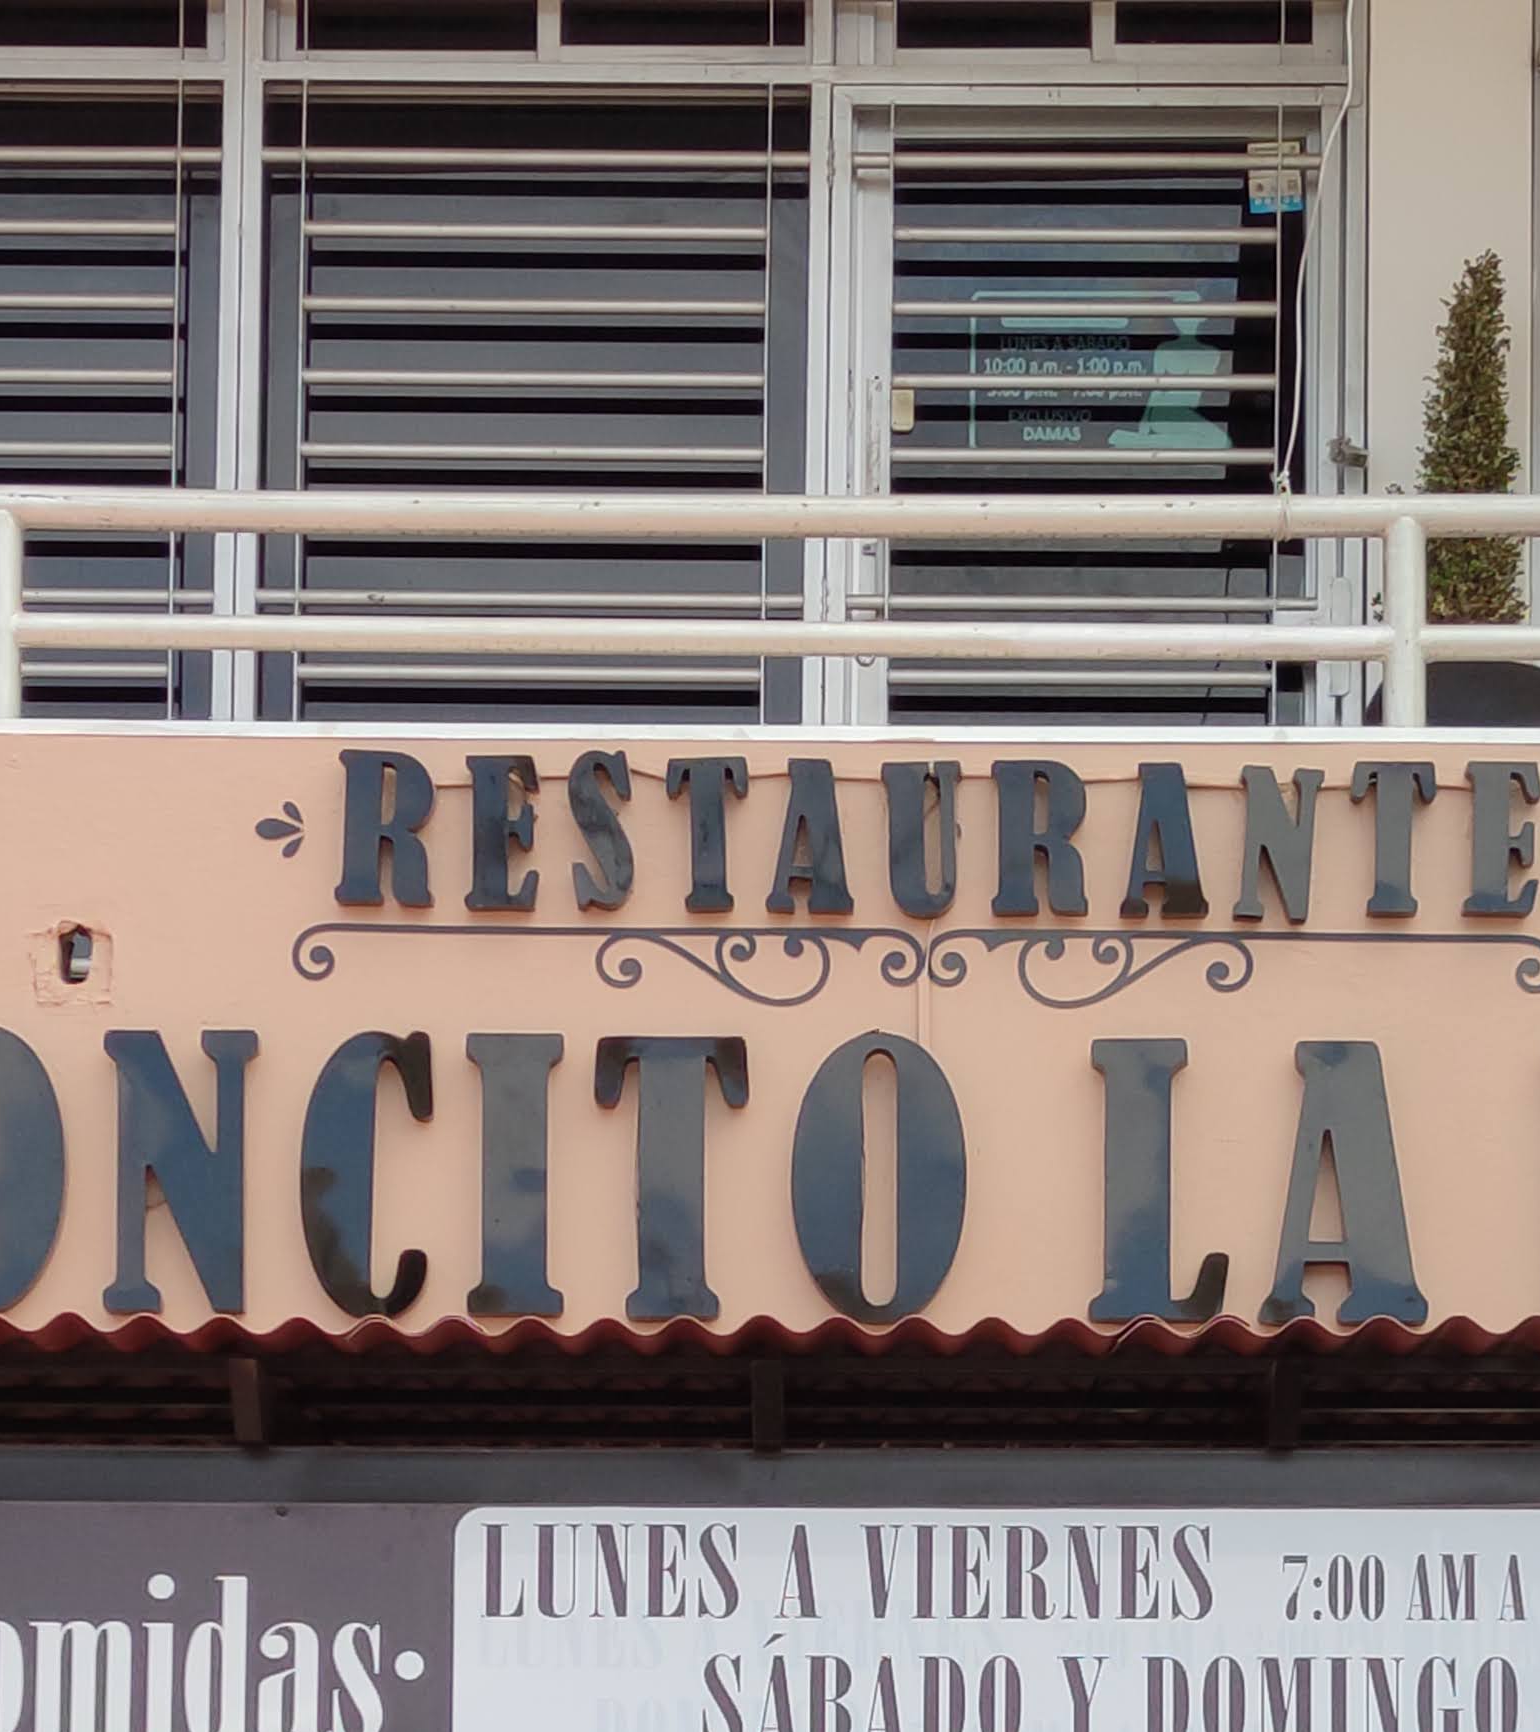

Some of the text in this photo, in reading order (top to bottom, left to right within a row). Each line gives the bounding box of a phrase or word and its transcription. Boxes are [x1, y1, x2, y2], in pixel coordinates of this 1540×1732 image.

[983, 357, 1026, 374] 10:00
[1029, 361, 1062, 374] a.m.
[1076, 357, 1110, 374] 1:00
[1008, 408, 1093, 423] EXCLUSIVO
[1023, 426, 1082, 442] DAMAS
[1091, 1038, 1430, 1328] LA
[482, 1523, 739, 1619] LUNES
[780, 1524, 822, 1619] A
[861, 1524, 1213, 1621] VIERNES
[1282, 1554, 1385, 1621] 7:00
[1406, 1553, 1476, 1621] AM
[1498, 1554, 1526, 1621] A
